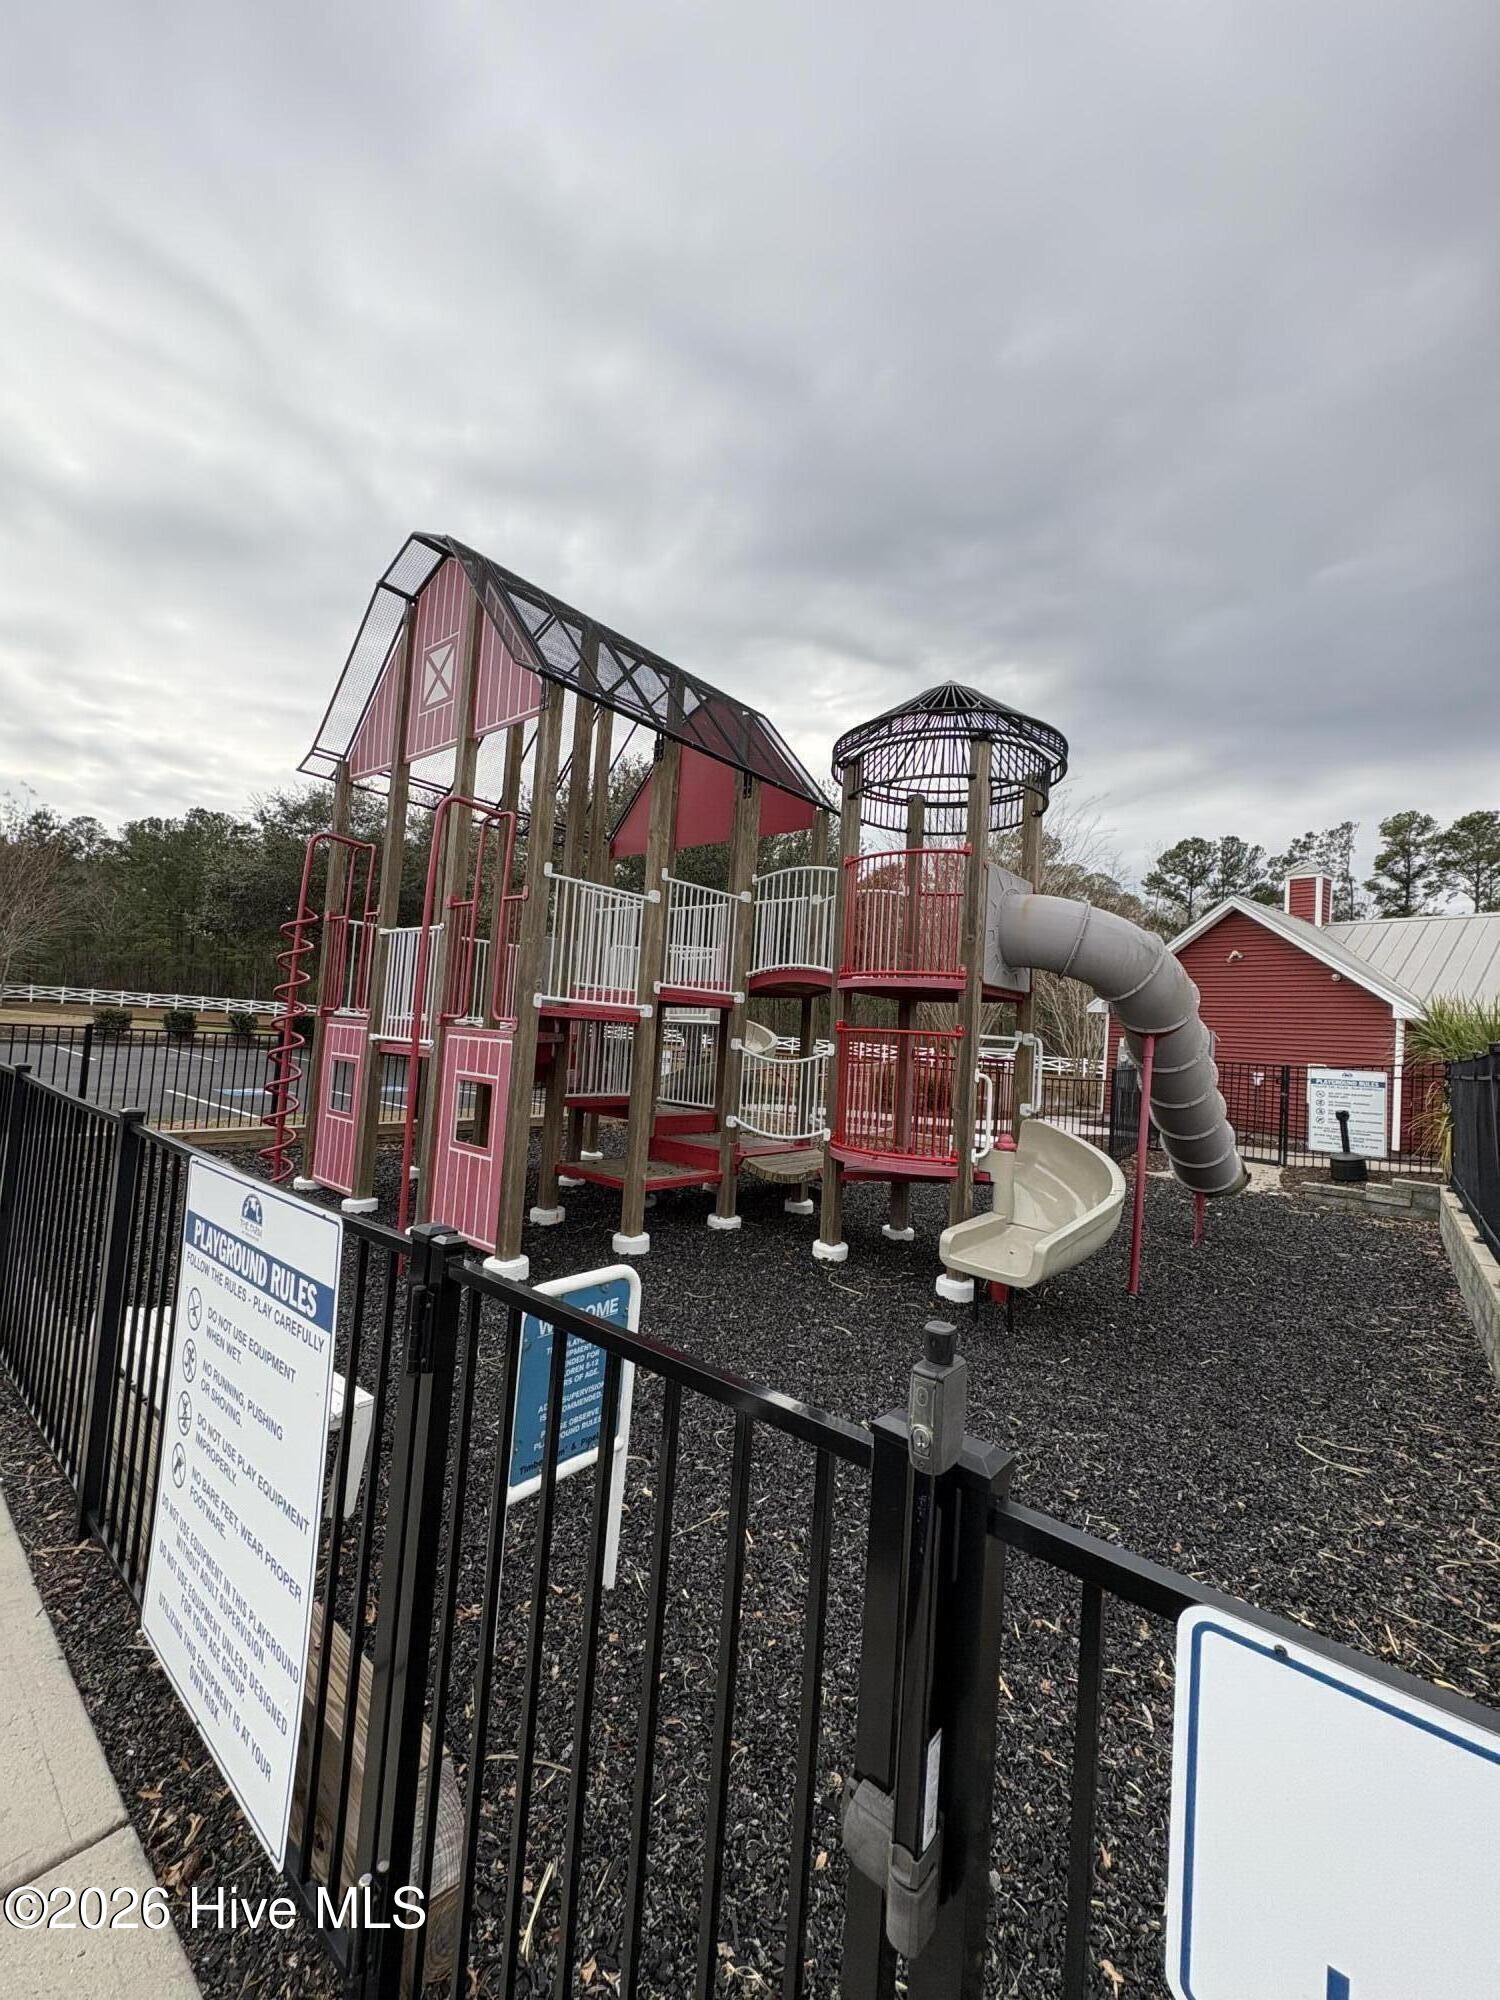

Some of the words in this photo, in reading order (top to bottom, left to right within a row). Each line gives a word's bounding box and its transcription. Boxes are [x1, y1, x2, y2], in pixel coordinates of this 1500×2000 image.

[186, 1251, 209, 1278] FOLLOW
[211, 1267, 223, 1287] THE
[224, 1275, 246, 1302] RULES
[252, 1293, 272, 1319] PLAY
[273, 1307, 324, 1355] CAREFULLY
[193, 1218, 268, 1289] PLAYGROUND
[270, 1260, 319, 1320] RULES
[539, 1297, 619, 1335] WOME
[205, 1324, 224, 1351] WHEN
[226, 1340, 242, 1365] WET.
[207, 1306, 217, 1324] DO
[218, 1314, 231, 1335] NOT
[232, 1325, 247, 1347] USE
[248, 1337, 296, 1385] EQUIPMENT
[200, 1377, 209, 1397] OR
[210, 1387, 242, 1428] SHOVING.
[202, 1359, 212, 1378] NO
[213, 1368, 245, 1409] RUNNING,
[247, 1398, 283, 1442] PUSHING
[195, 1431, 237, 1487] IMPROPERLY.
[197, 1411, 206, 1431] DO
[207, 1422, 220, 1446] NOT
[222, 1437, 236, 1462] USE
[237, 1453, 257, 1485] PLAY
[257, 1473, 309, 1539] EQUIPMENT
[189, 1484, 226, 1541] FOOTWARE.
[191, 1465, 201, 1487] NO
[202, 1478, 219, 1509] BARE
[220, 1499, 239, 1532] FEET,
[239, 1521, 263, 1561] WEAR
[264, 1549, 301, 1606] PROPER
[159, 1539, 166, 1559] DO
[166, 1550, 176, 1575] NOT
[177, 1565, 187, 1590] USE
[188, 1581, 220, 1640] EQUIPMENT
[221, 1630, 247, 1680] UNLESS
[249, 1670, 287, 1739] DESIGNED
[162, 1492, 168, 1512] DO
[169, 1502, 179, 1526] NOT
[179, 1515, 189, 1540] USE
[190, 1529, 222, 1585] EQUIPMENT
[223, 1574, 230, 1596] IN
[231, 1584, 247, 1618] THIS
[248, 1606, 298, 1688] PLAYGROUND
[176, 1532, 199, 1575] WITHOUT
[200, 1565, 218, 1602] ADULT
[219, 1592, 266, 1670] SUPERVISION.
[158, 1591, 182, 1640] UTILIZING
[184, 1631, 196, 1662] THIS
[197, 1652, 231, 1720] EQUIPMENT
[233, 1709, 240, 1733] IS
[241, 1722, 249, 1749] AT
[250, 1738, 271, 1784] YOUR
[180, 1593, 191, 1620] FOR
[192, 1610, 208, 1646] YOUR
[208, 1635, 220, 1666] AGE
[221, 1655, 245, 1703] GROUP.
[189, 1663, 203, 1697] OWN
[203, 1687, 220, 1727] RISK.
